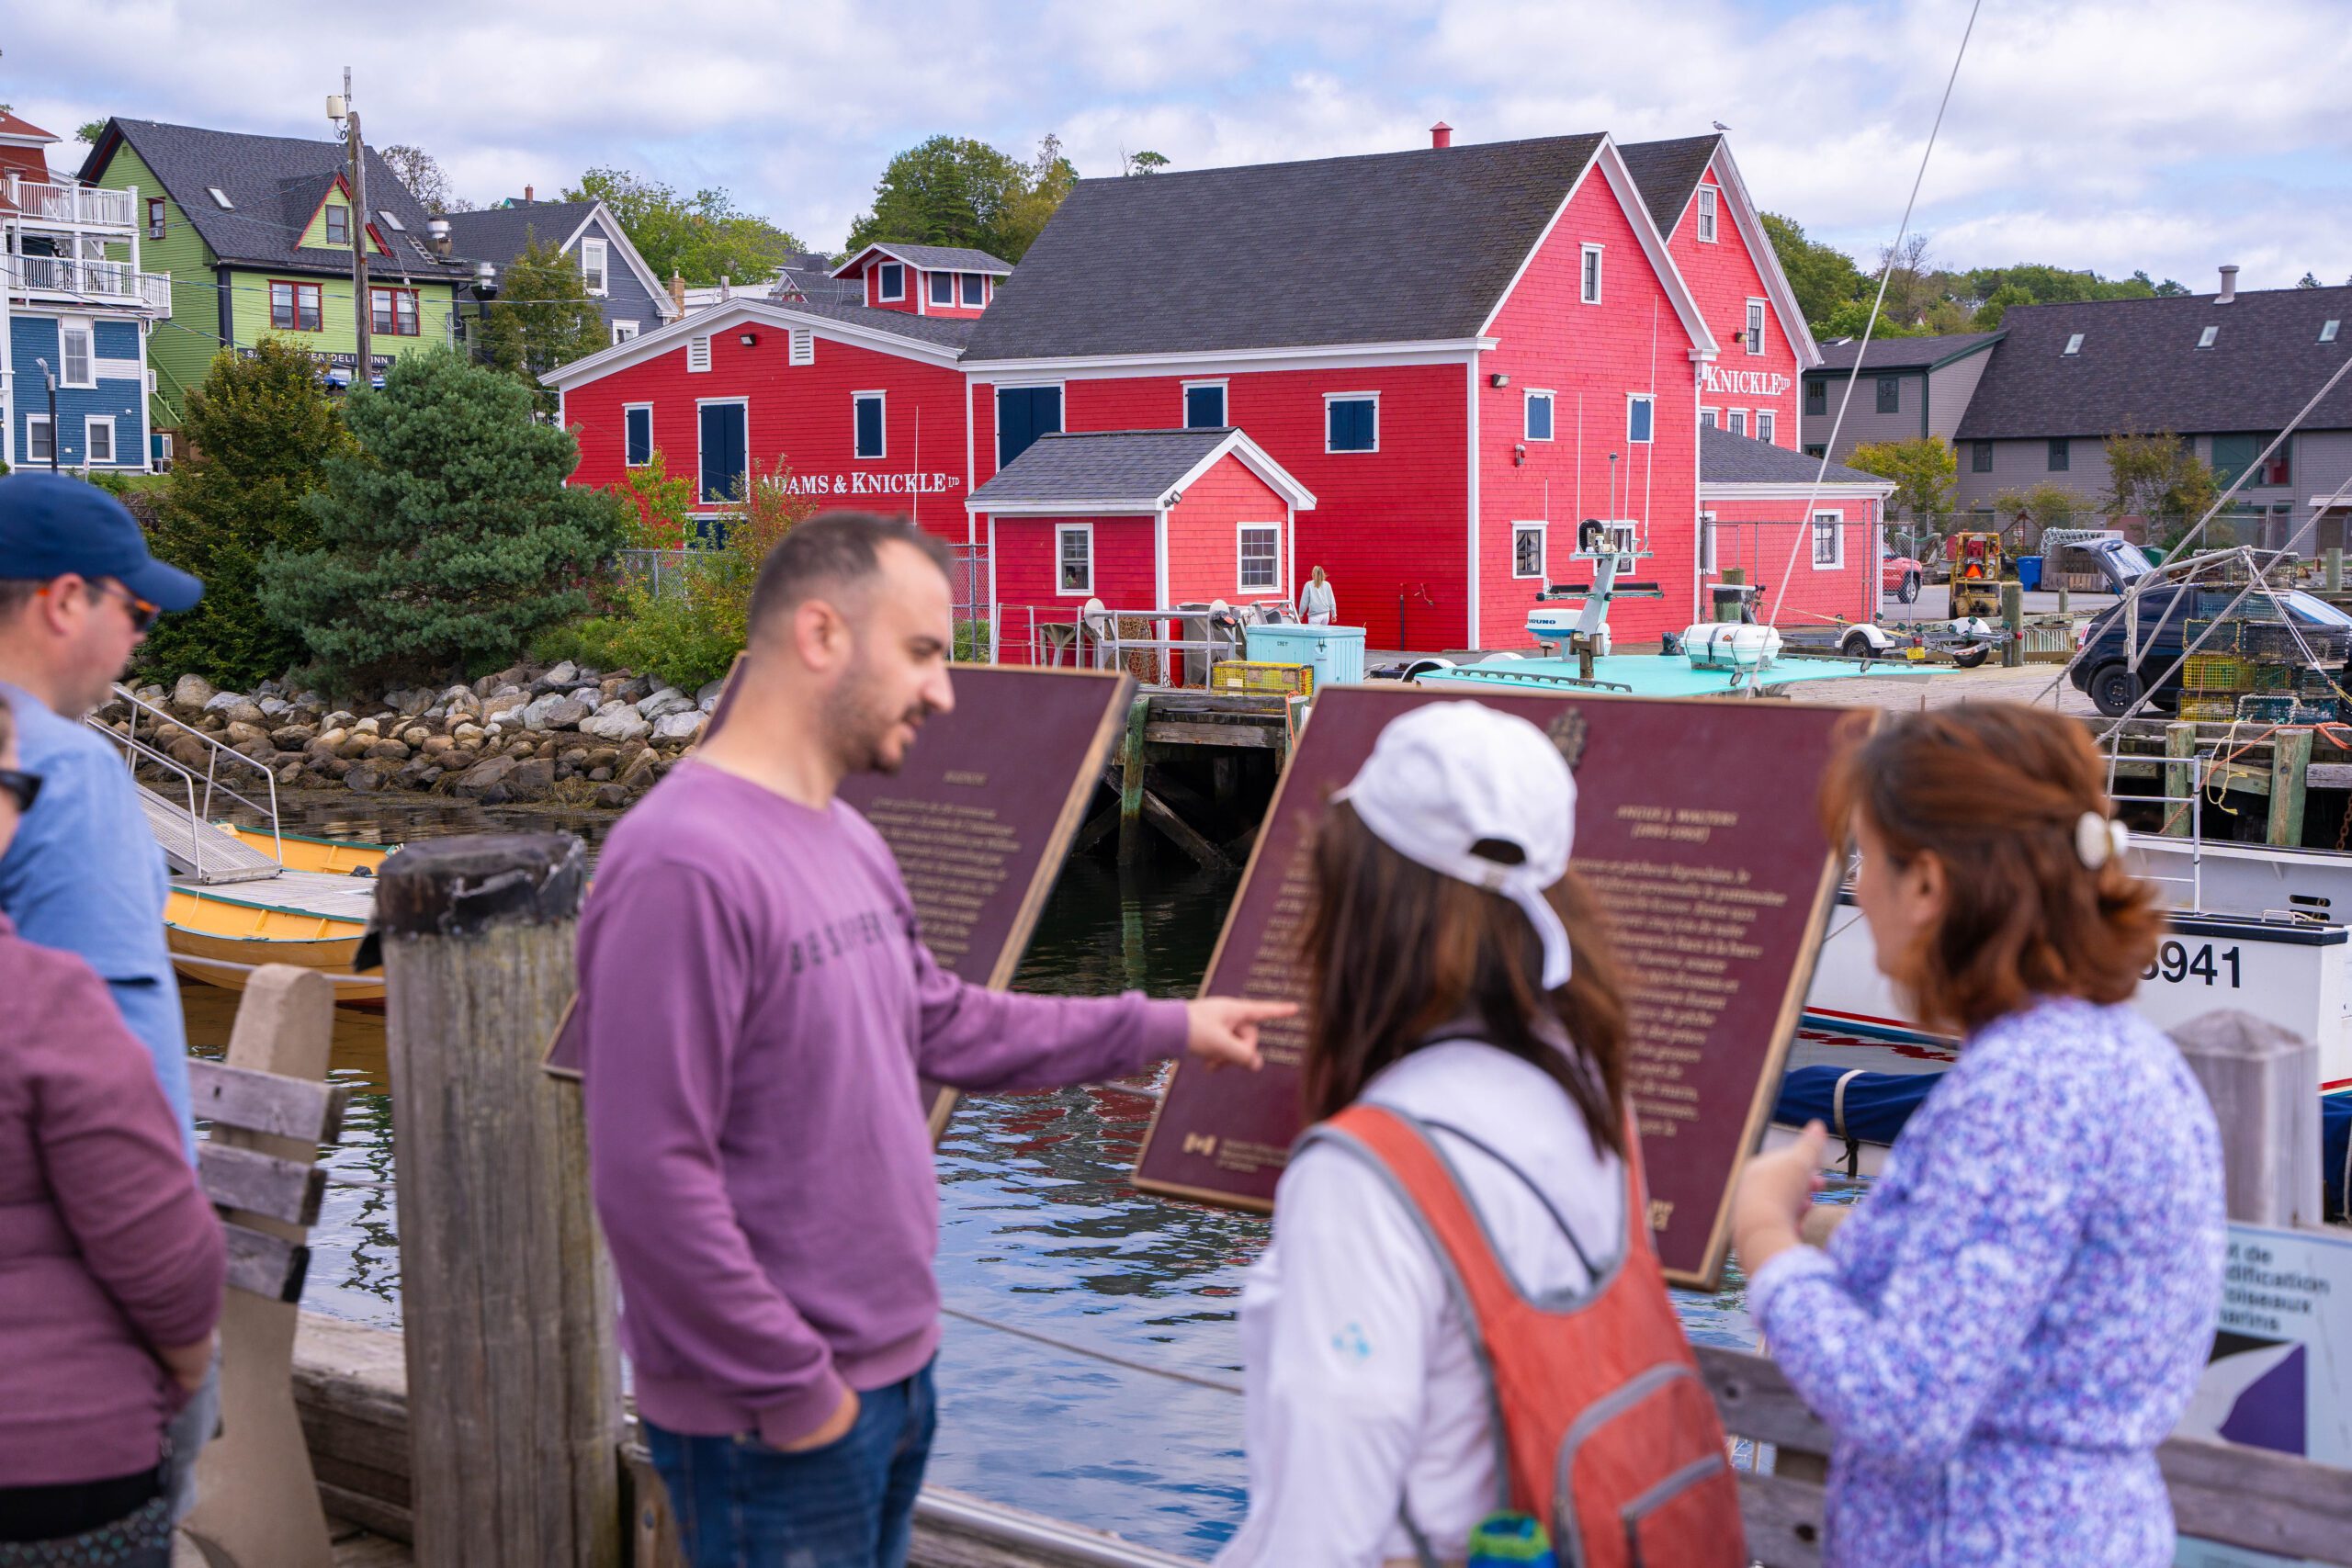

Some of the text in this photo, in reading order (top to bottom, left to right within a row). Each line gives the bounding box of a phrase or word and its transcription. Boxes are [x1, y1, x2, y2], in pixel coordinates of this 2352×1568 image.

[331, 354, 355, 363] DELI
[371, 355, 389, 364] INN
[1705, 366, 1781, 396] KNICKLE
[833, 474, 848, 494] &
[851, 471, 946, 493] KNICKLE
